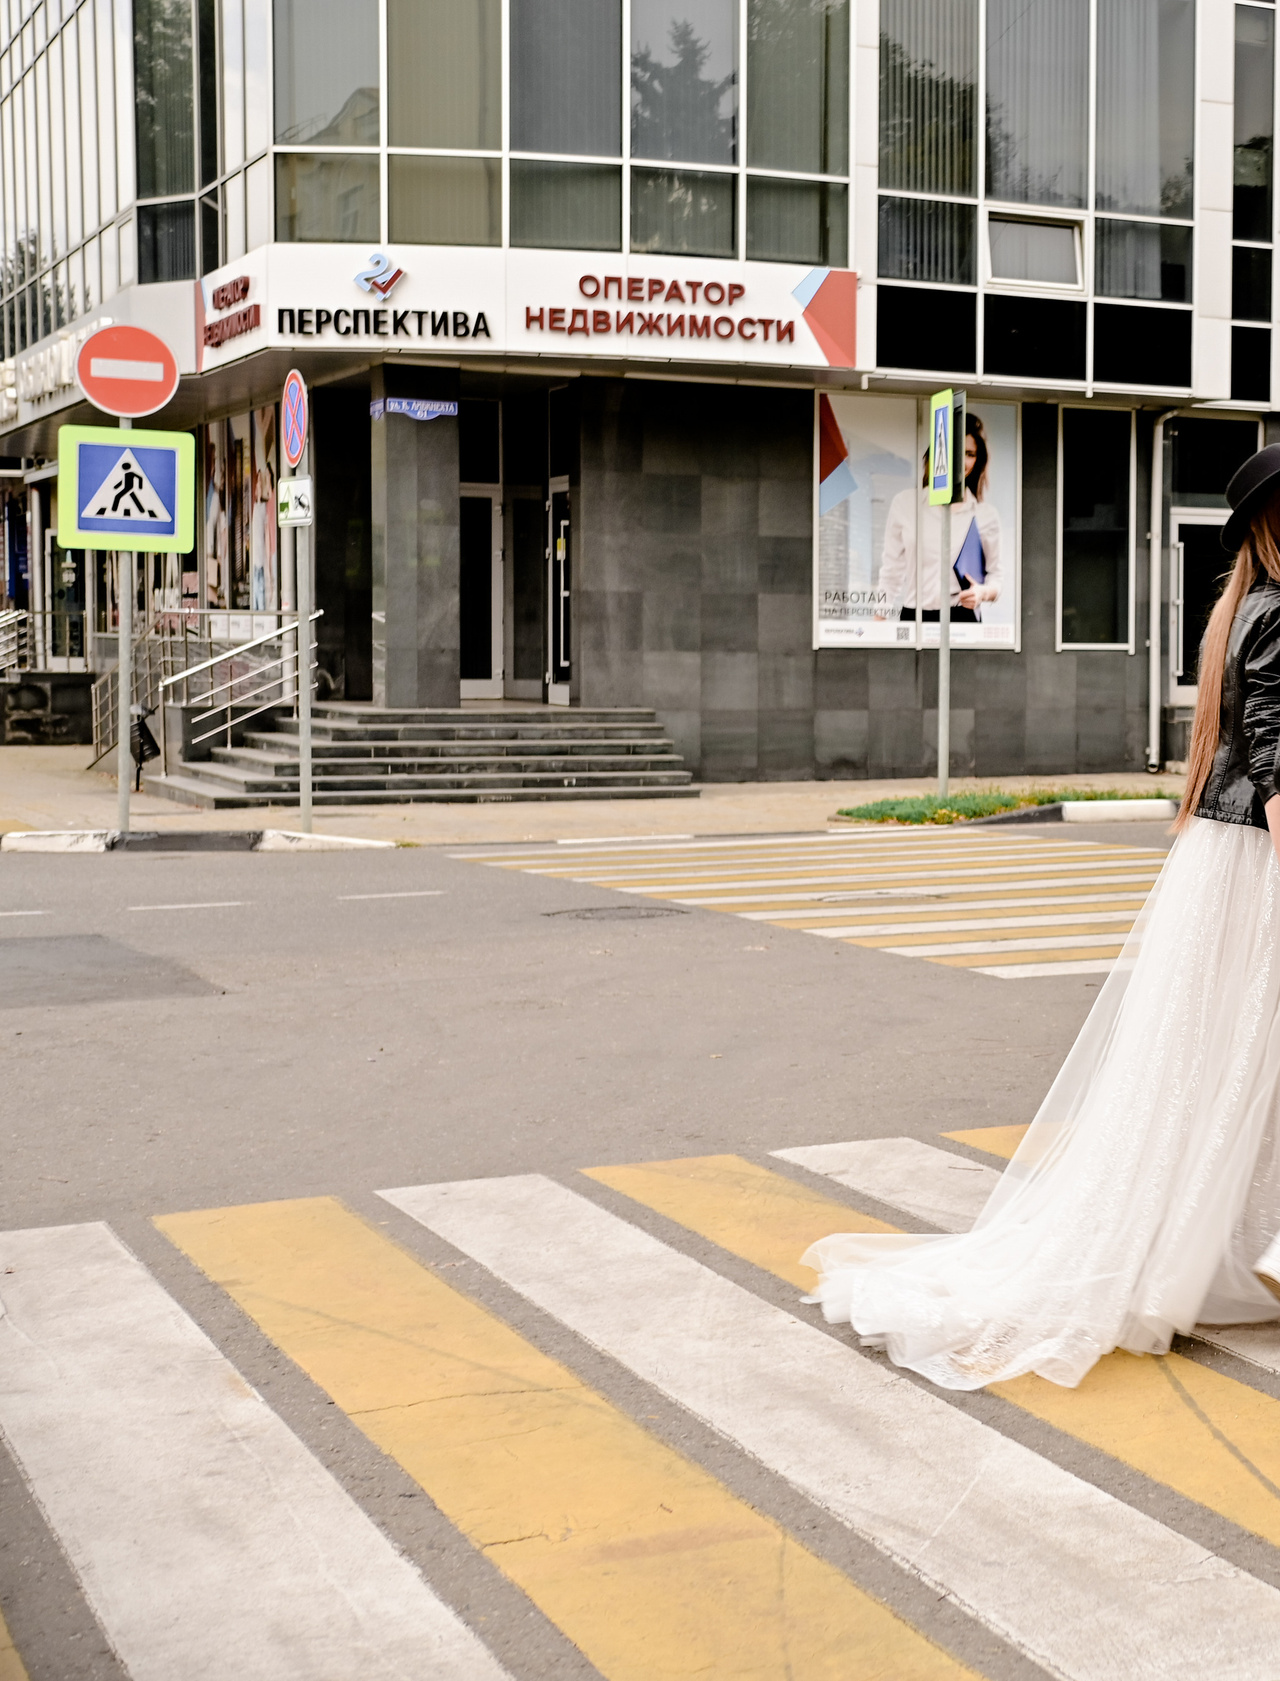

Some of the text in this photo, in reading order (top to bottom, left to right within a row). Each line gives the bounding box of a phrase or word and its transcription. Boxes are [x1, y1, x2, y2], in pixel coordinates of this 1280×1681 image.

[579, 275, 745, 305] ОПЕРАТОР
[277, 308, 491, 338] ПЕРСПЕКТИВА
[525, 307, 795, 343] НЕДВИЖИМОСТИ
[824, 591, 887, 604] РАБОТАЙ
